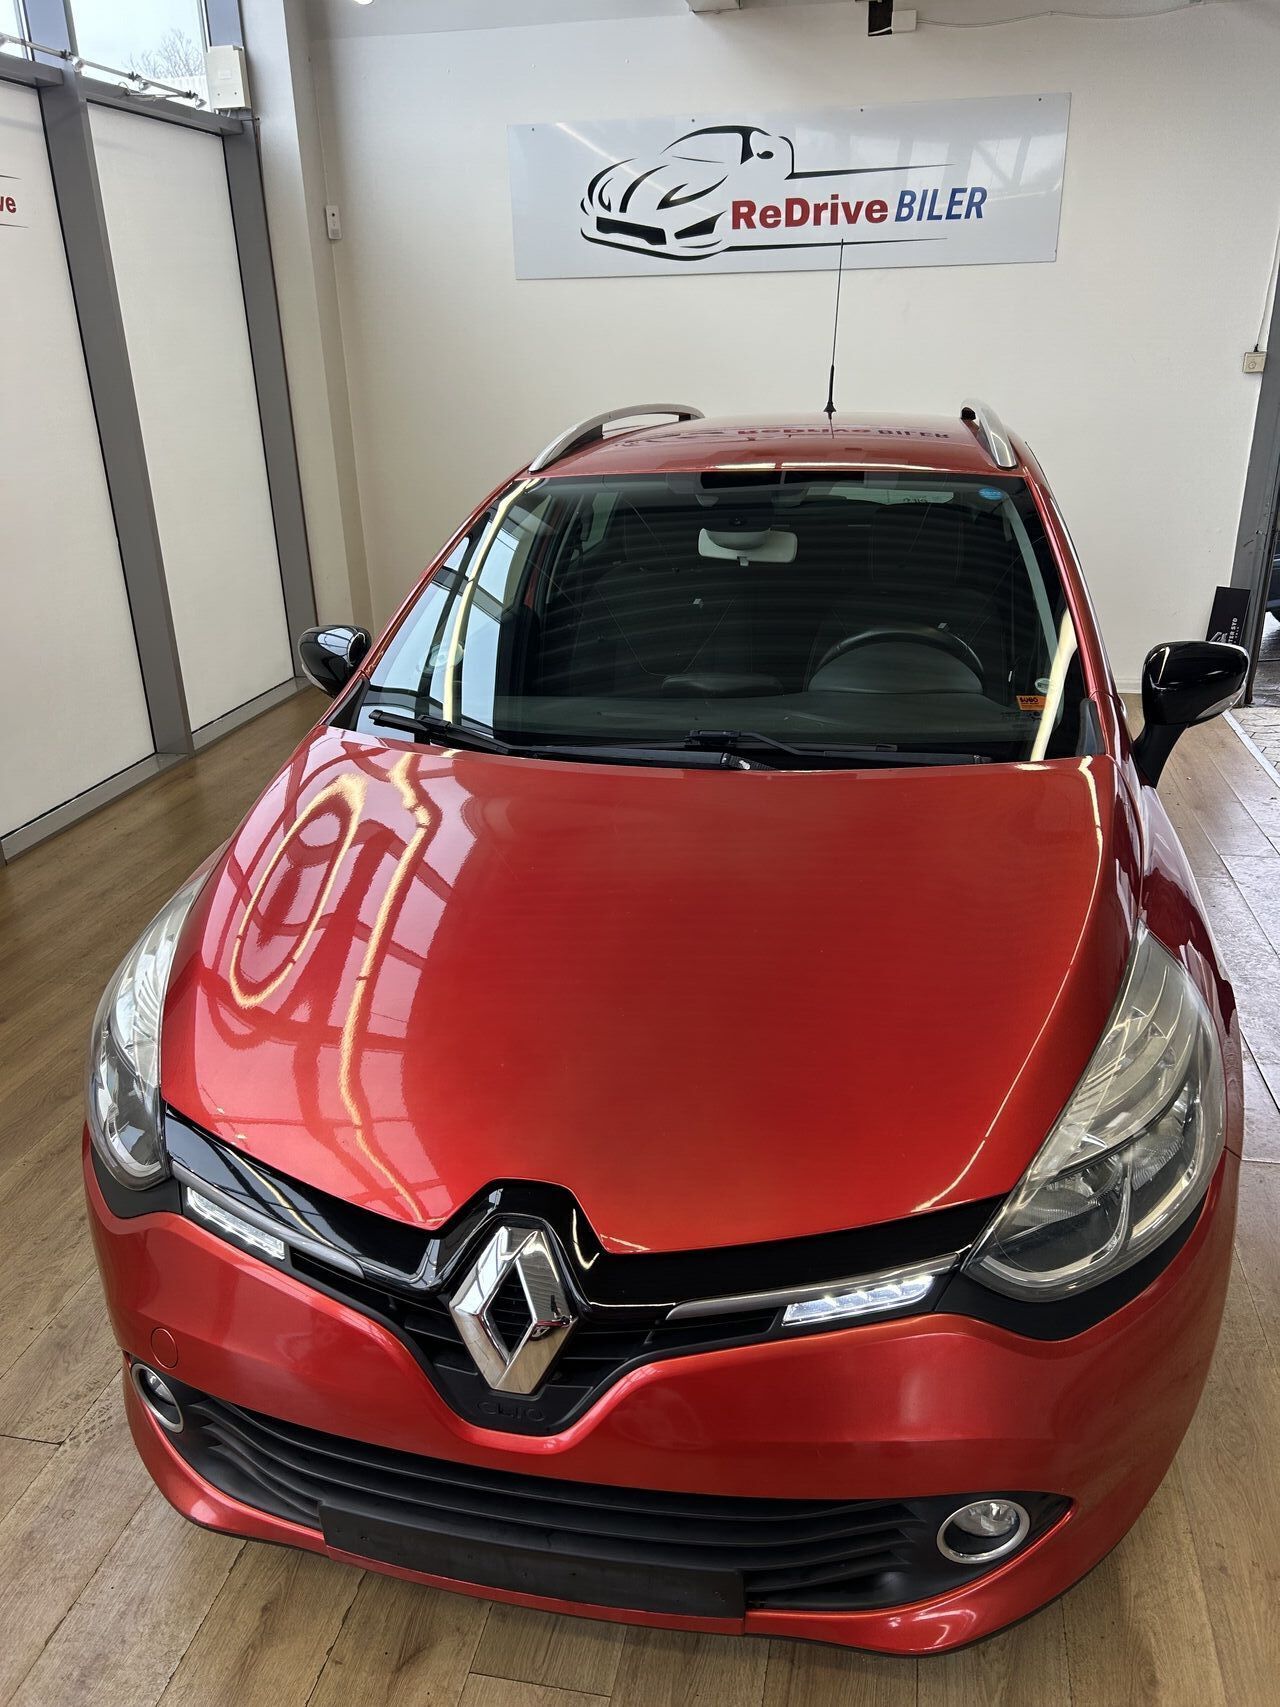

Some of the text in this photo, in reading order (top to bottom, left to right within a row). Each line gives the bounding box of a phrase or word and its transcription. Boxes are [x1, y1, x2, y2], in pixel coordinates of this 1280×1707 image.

[731, 186, 988, 230] ReDrive BILER
[477, 1401, 545, 1422] CLIO
